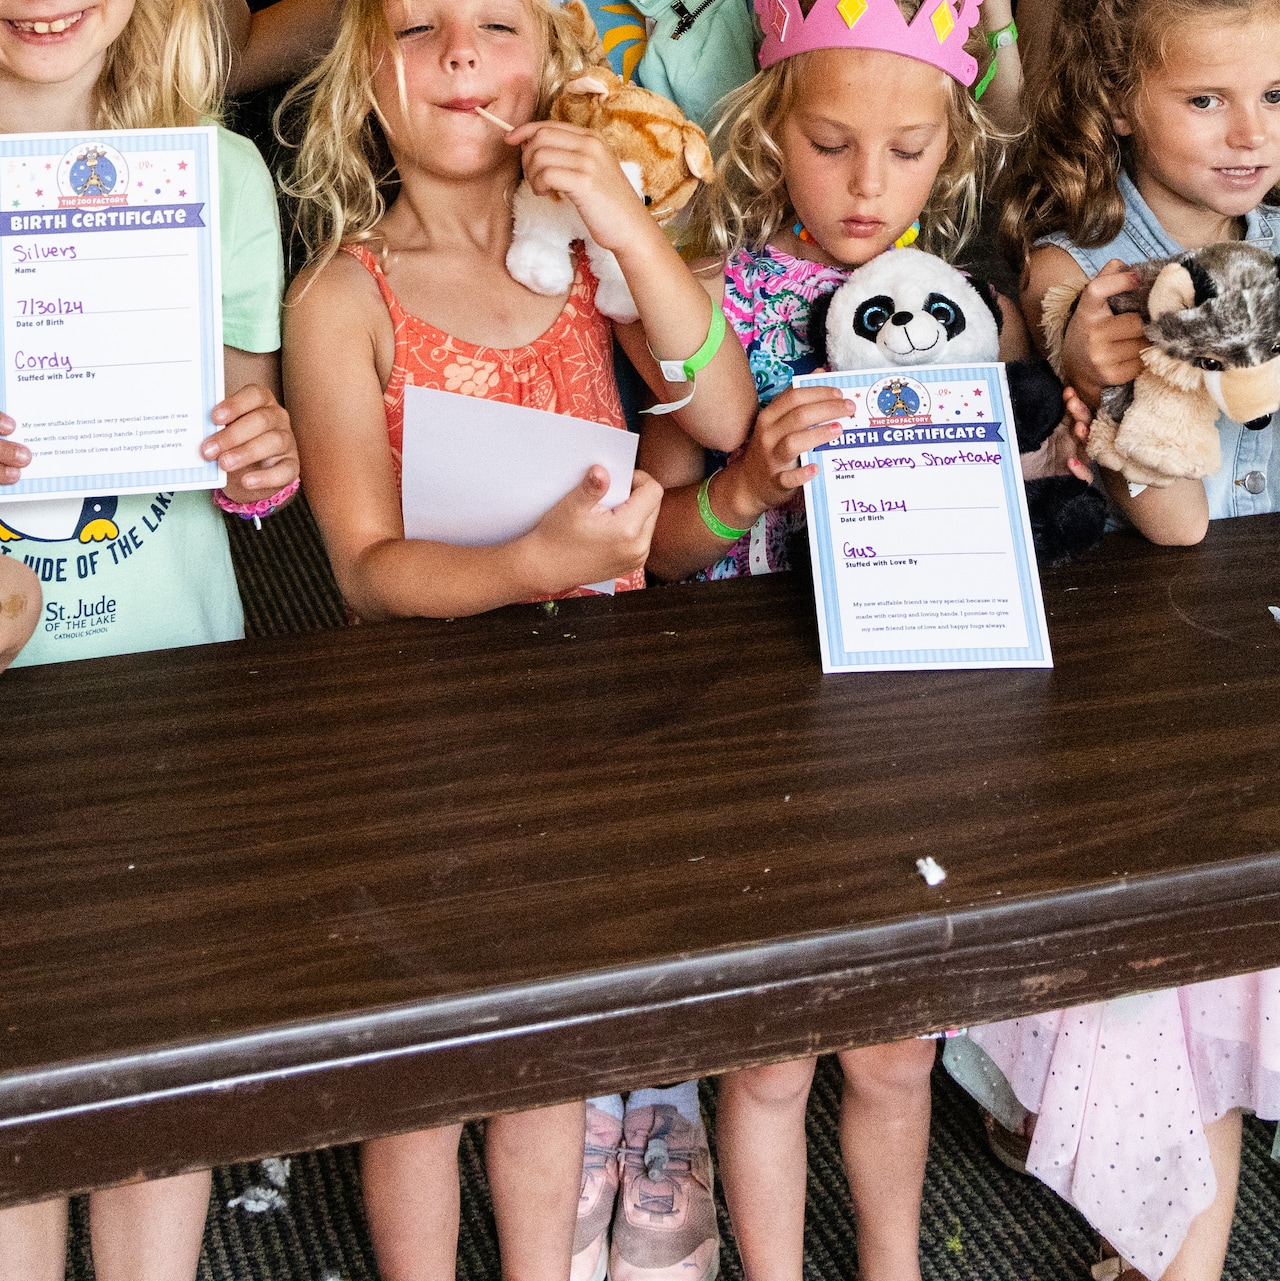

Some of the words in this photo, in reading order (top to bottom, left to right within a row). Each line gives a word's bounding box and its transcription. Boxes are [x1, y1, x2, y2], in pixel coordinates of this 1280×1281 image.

[10, 215, 67, 231] BIRTH
[13, 243, 77, 262] Silvers
[17, 298, 83, 315] 7/30/24
[15, 351, 72, 372] Cordy
[18, 374, 44, 382] Stuffed
[832, 457, 915, 471] Strawberry
[76, 550, 99, 579] OF
[106, 526, 144, 564] THE
[142, 491, 175, 532] LAK
[843, 542, 876, 558] Gus
[73, 595, 116, 619] Jude
[45, 622, 60, 632] OF
[66, 620, 86, 630] THE
[91, 614, 116, 626] LAKE
[54, 631, 84, 640] CATHOLIC
[85, 627, 108, 636] SCHOOL
